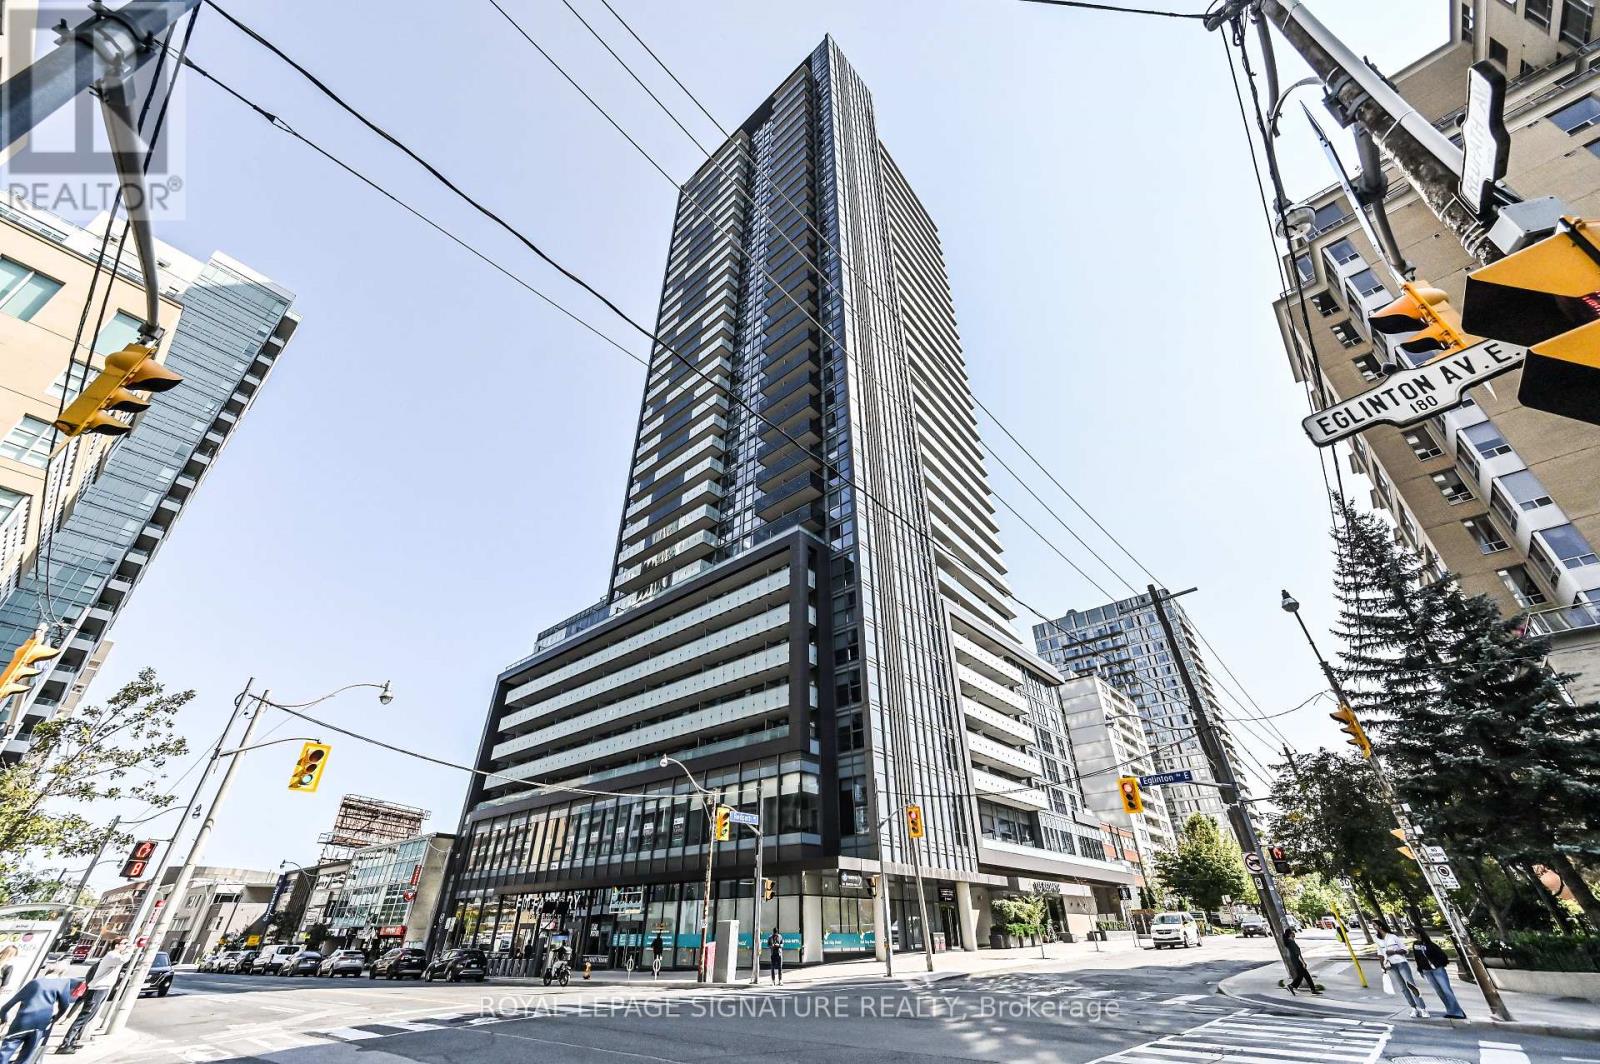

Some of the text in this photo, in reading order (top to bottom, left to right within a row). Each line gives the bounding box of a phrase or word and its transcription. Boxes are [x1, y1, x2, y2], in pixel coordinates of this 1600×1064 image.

[1316, 374, 1436, 436] EGLINTON
[1409, 394, 1439, 415] 180
[1142, 774, 1174, 786] Eglinton
[1183, 771, 1190, 780] E
